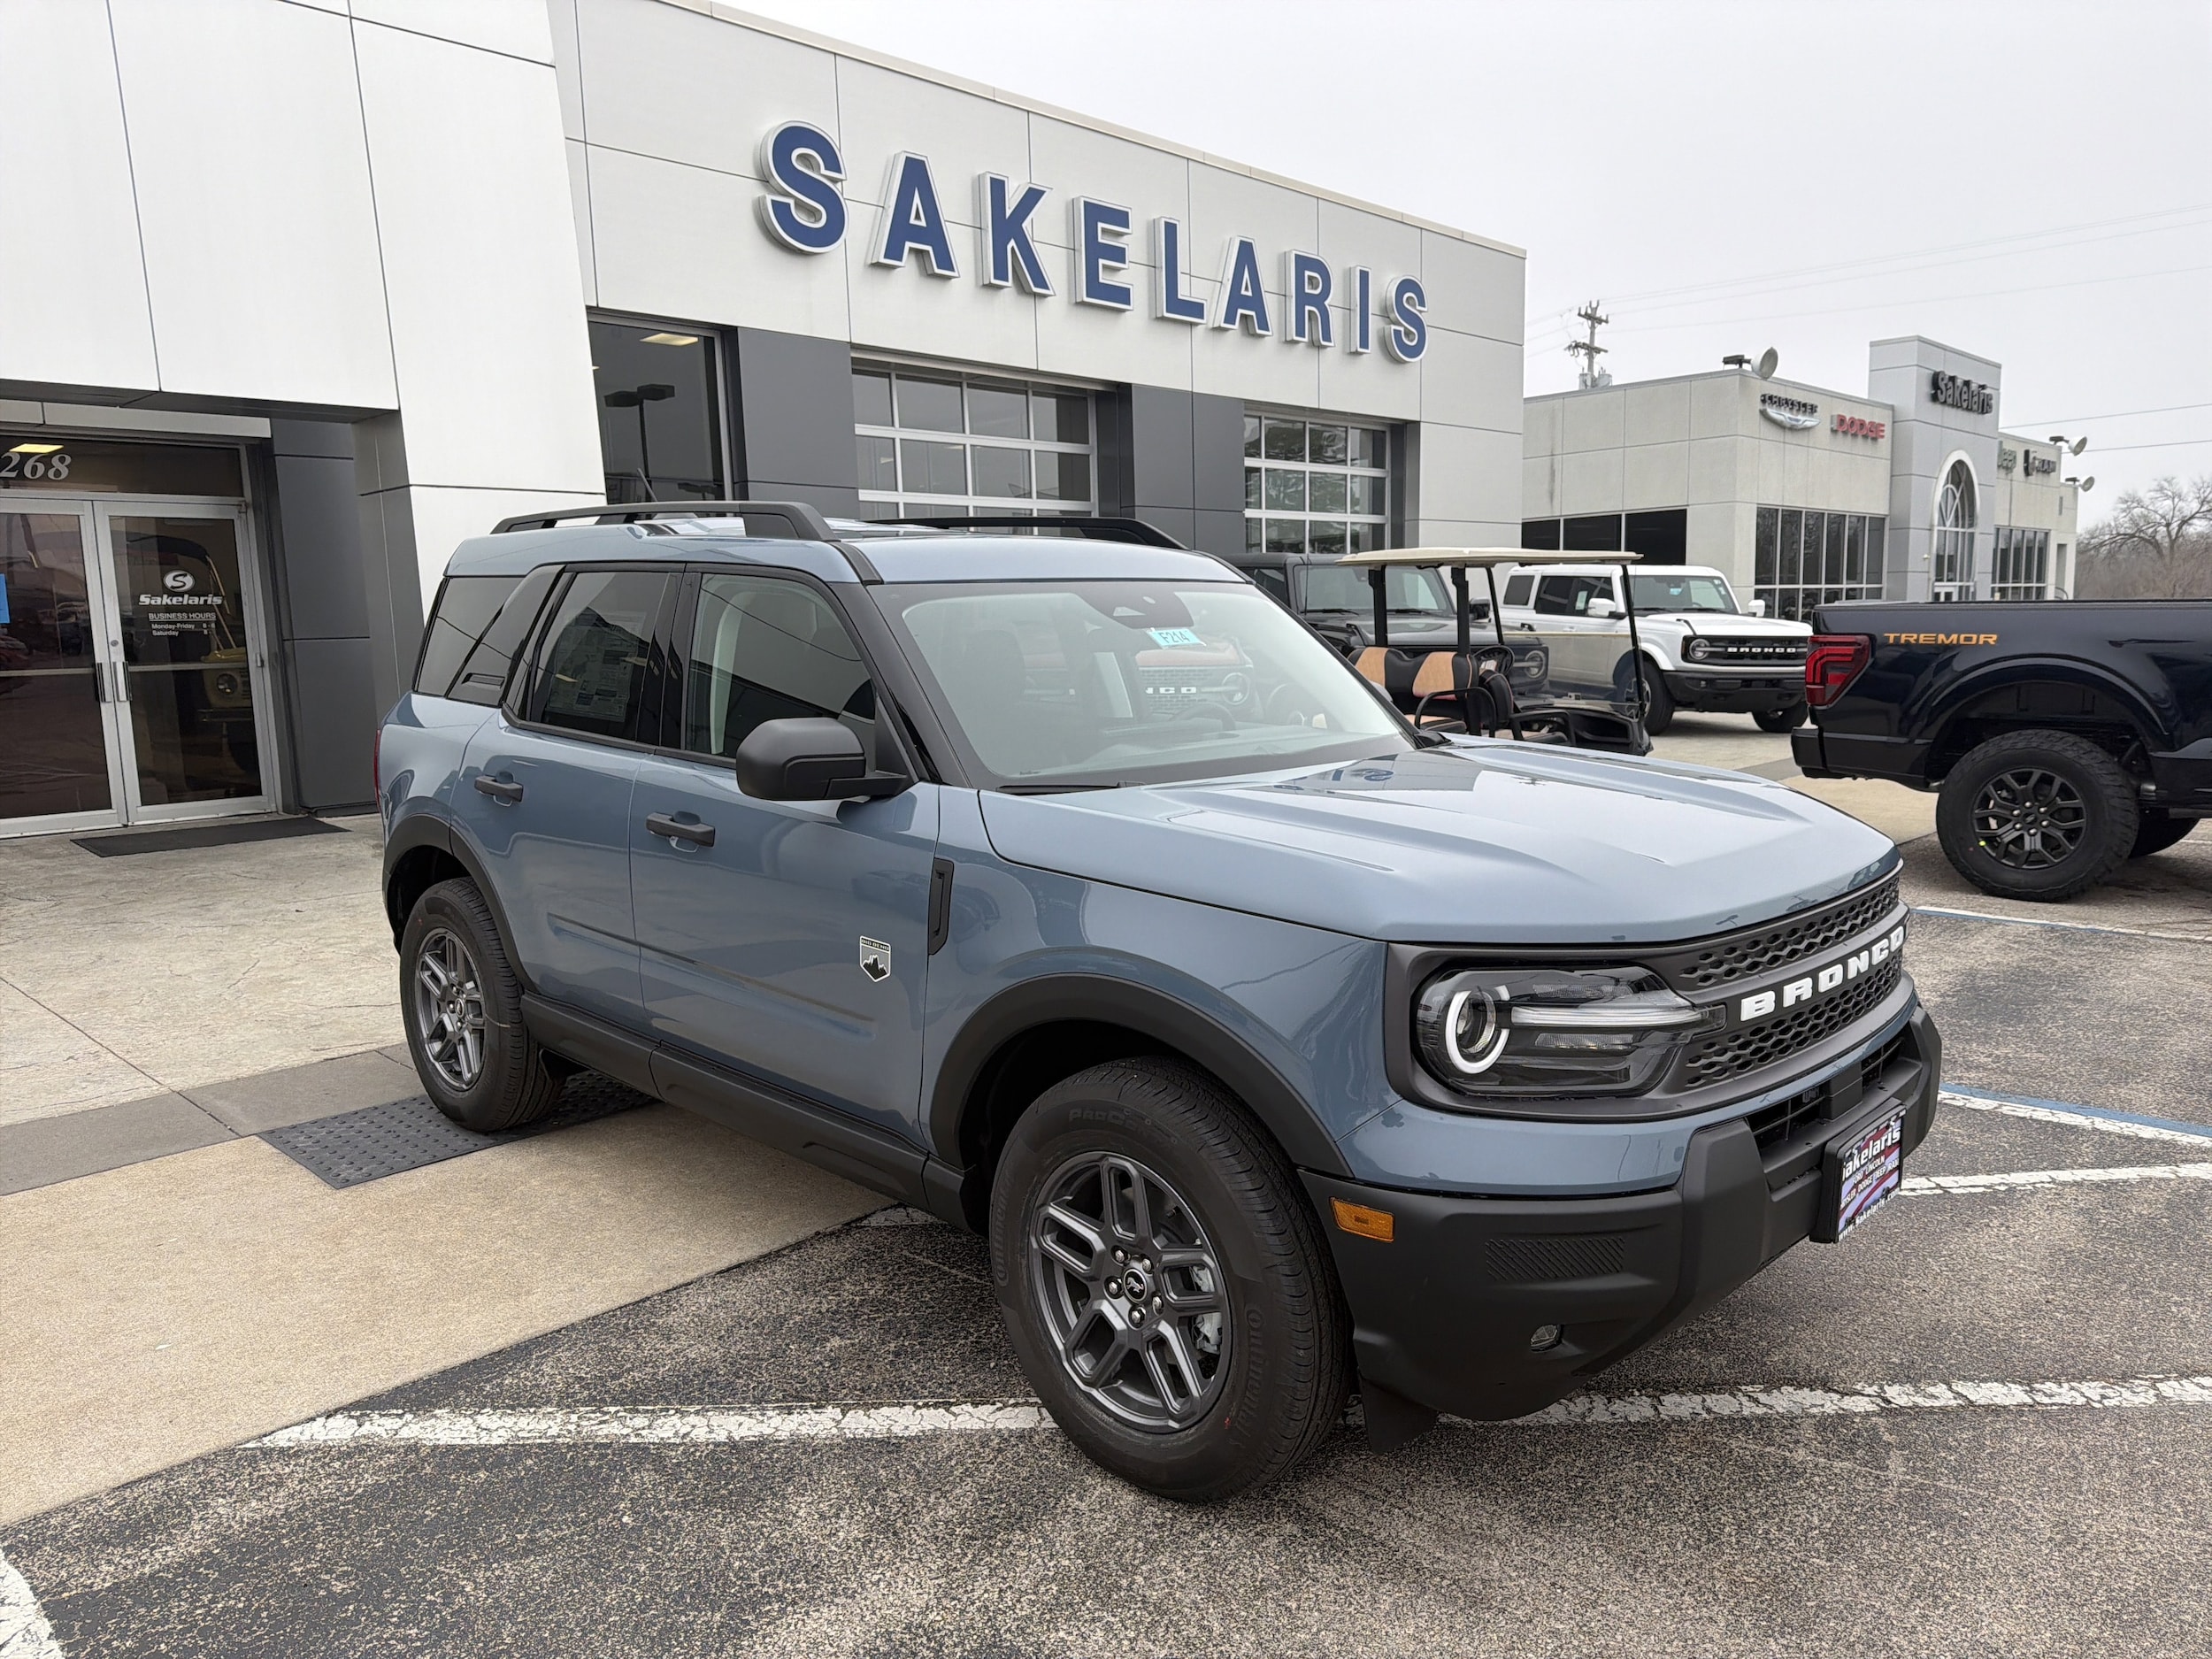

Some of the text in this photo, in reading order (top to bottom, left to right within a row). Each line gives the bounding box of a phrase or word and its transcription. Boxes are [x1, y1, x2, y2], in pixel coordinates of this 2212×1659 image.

[757, 119, 1429, 364] SAKELARIS
[1933, 370, 1993, 415] Sakelaris
[1833, 413, 1886, 439] DODGE
[0, 451, 72, 480] 268
[139, 594, 223, 605] Sakelaris
[1884, 633, 1998, 645] TREMOR
[1740, 926, 1904, 1022] BRONCO
